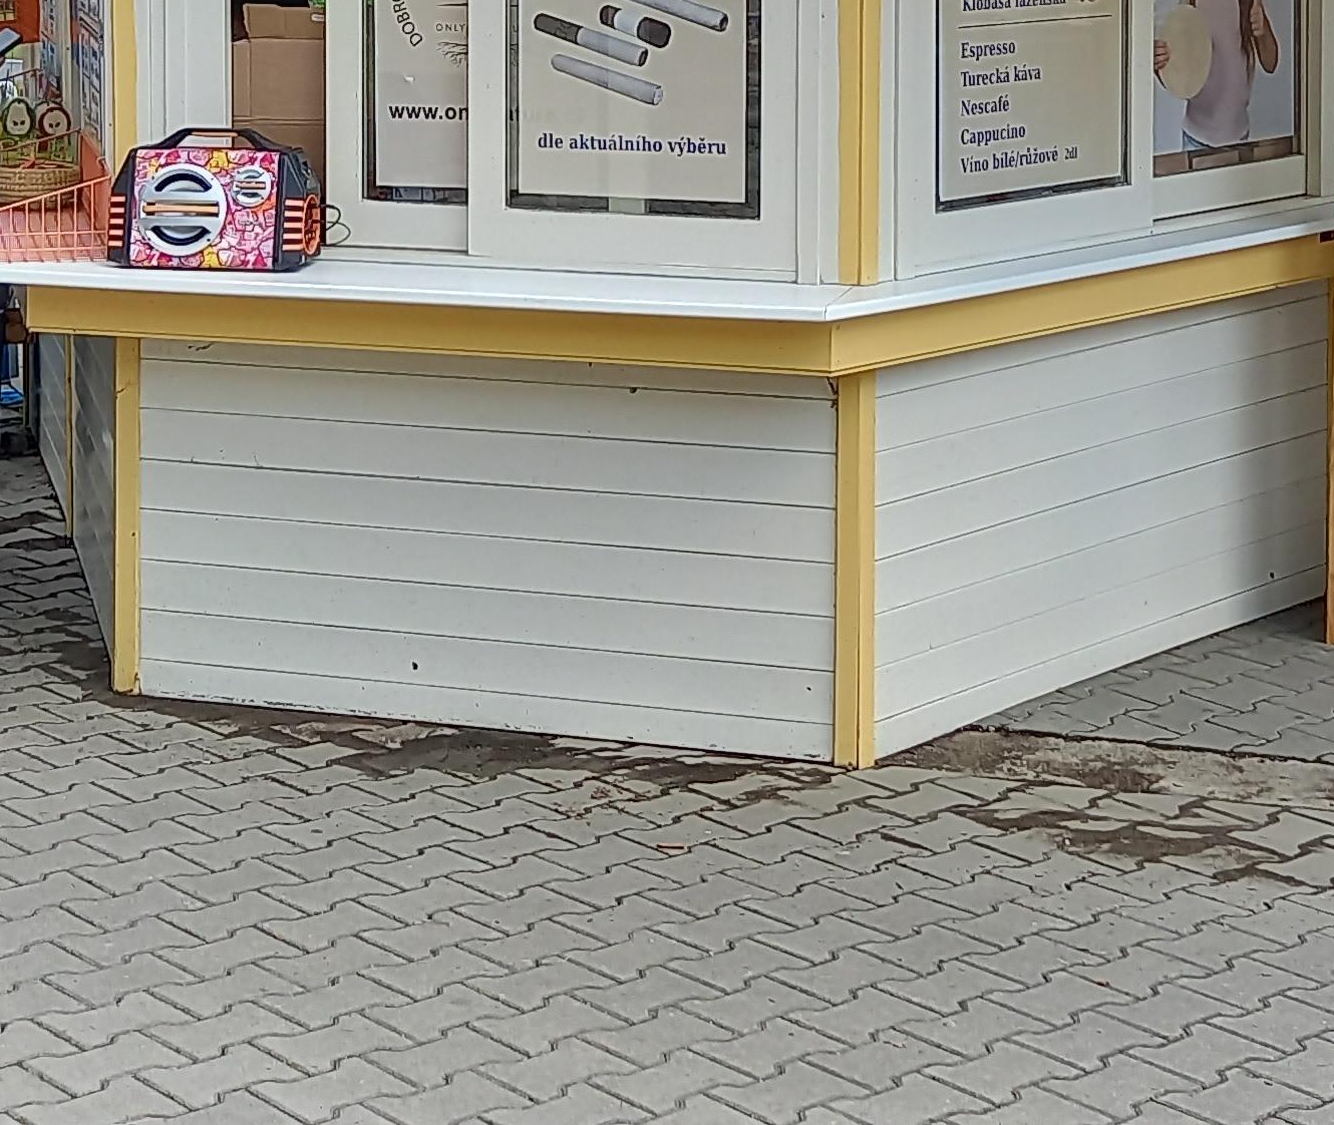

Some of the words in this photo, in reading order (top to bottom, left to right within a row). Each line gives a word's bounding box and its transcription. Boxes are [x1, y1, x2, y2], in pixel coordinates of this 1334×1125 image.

[435, 22, 466, 32] ONLY
[960, 41, 1016, 61] Espresso
[960, 66, 1010, 87] Turecká
[1014, 64, 1041, 82] káva
[960, 94, 1010, 117] Nescafé
[537, 132, 564, 149] dle
[569, 133, 663, 153] aktuálního
[667, 135, 727, 157] výběru
[960, 123, 1026, 147] Cappucino
[960, 155, 989, 174] Víno
[992, 145, 1059, 170] bílé/růžové
[1064, 146, 1078, 160] 2dl
